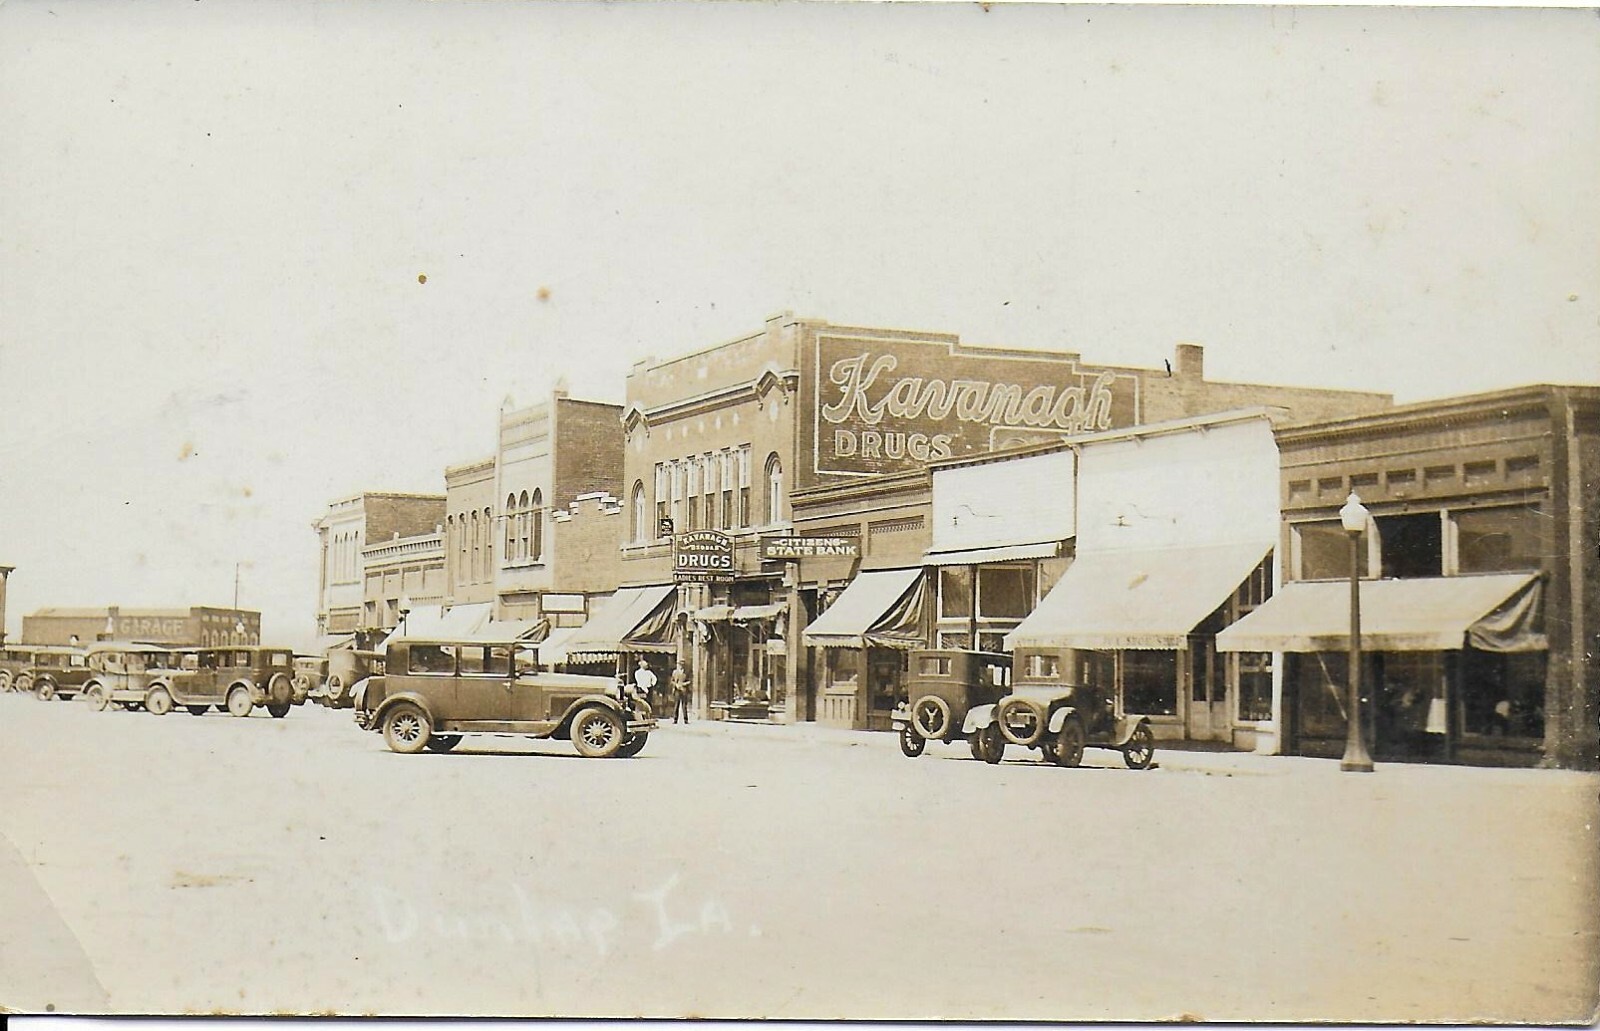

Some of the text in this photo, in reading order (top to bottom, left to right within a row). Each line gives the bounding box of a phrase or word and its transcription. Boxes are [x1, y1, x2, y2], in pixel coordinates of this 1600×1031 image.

[822, 352, 1113, 434] Kavanagh
[834, 429, 952, 460] DRUGS
[682, 533, 728, 547] KAVANAGH
[779, 538, 841, 546] CITIZENS
[767, 545, 857, 556] STATE BANK
[679, 554, 731, 568] DRUGS
[119, 618, 183, 636] GARAGE
